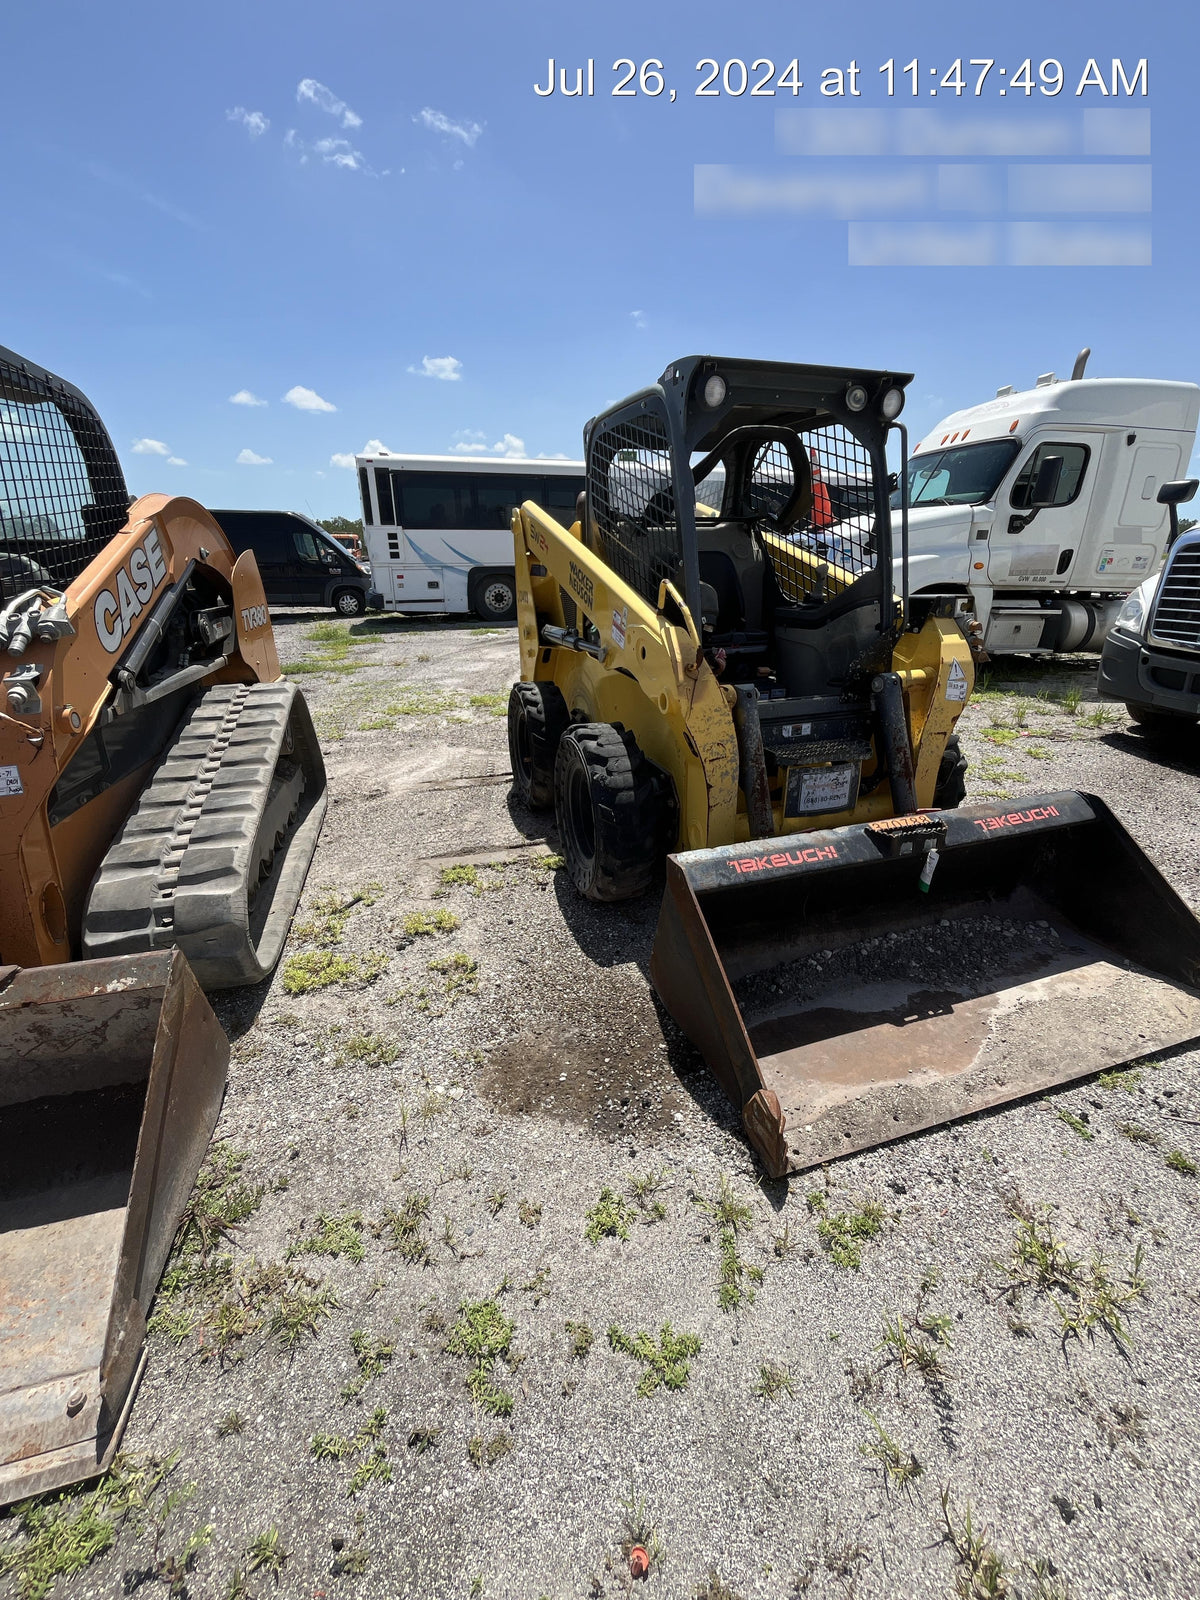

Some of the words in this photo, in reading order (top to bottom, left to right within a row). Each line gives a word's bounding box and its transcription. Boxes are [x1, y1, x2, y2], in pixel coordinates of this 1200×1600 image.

[94, 528, 168, 653] CASE
[569, 560, 594, 596] WACKER
[569, 573, 593, 611] NEUSON
[241, 603, 267, 632] TV380
